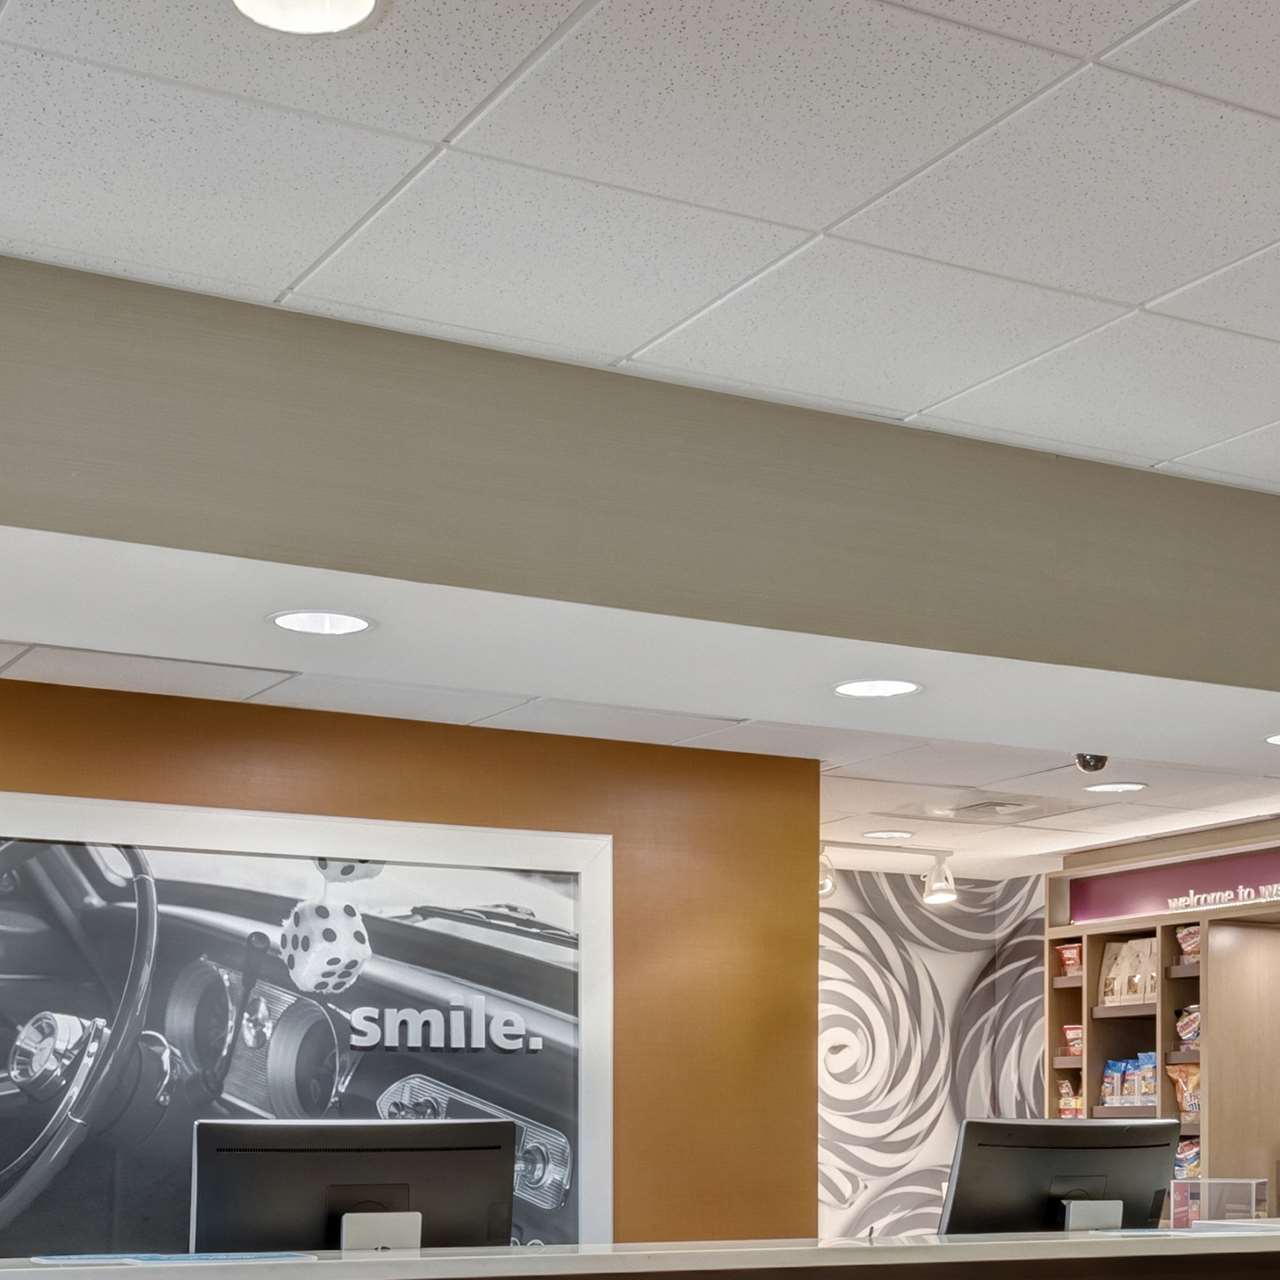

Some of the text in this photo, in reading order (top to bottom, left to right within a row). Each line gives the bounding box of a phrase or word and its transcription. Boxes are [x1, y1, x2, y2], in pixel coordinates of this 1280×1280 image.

[1167, 889, 1234, 911] welcome
[1237, 885, 1255, 903] to
[349, 994, 544, 1051] smile.
